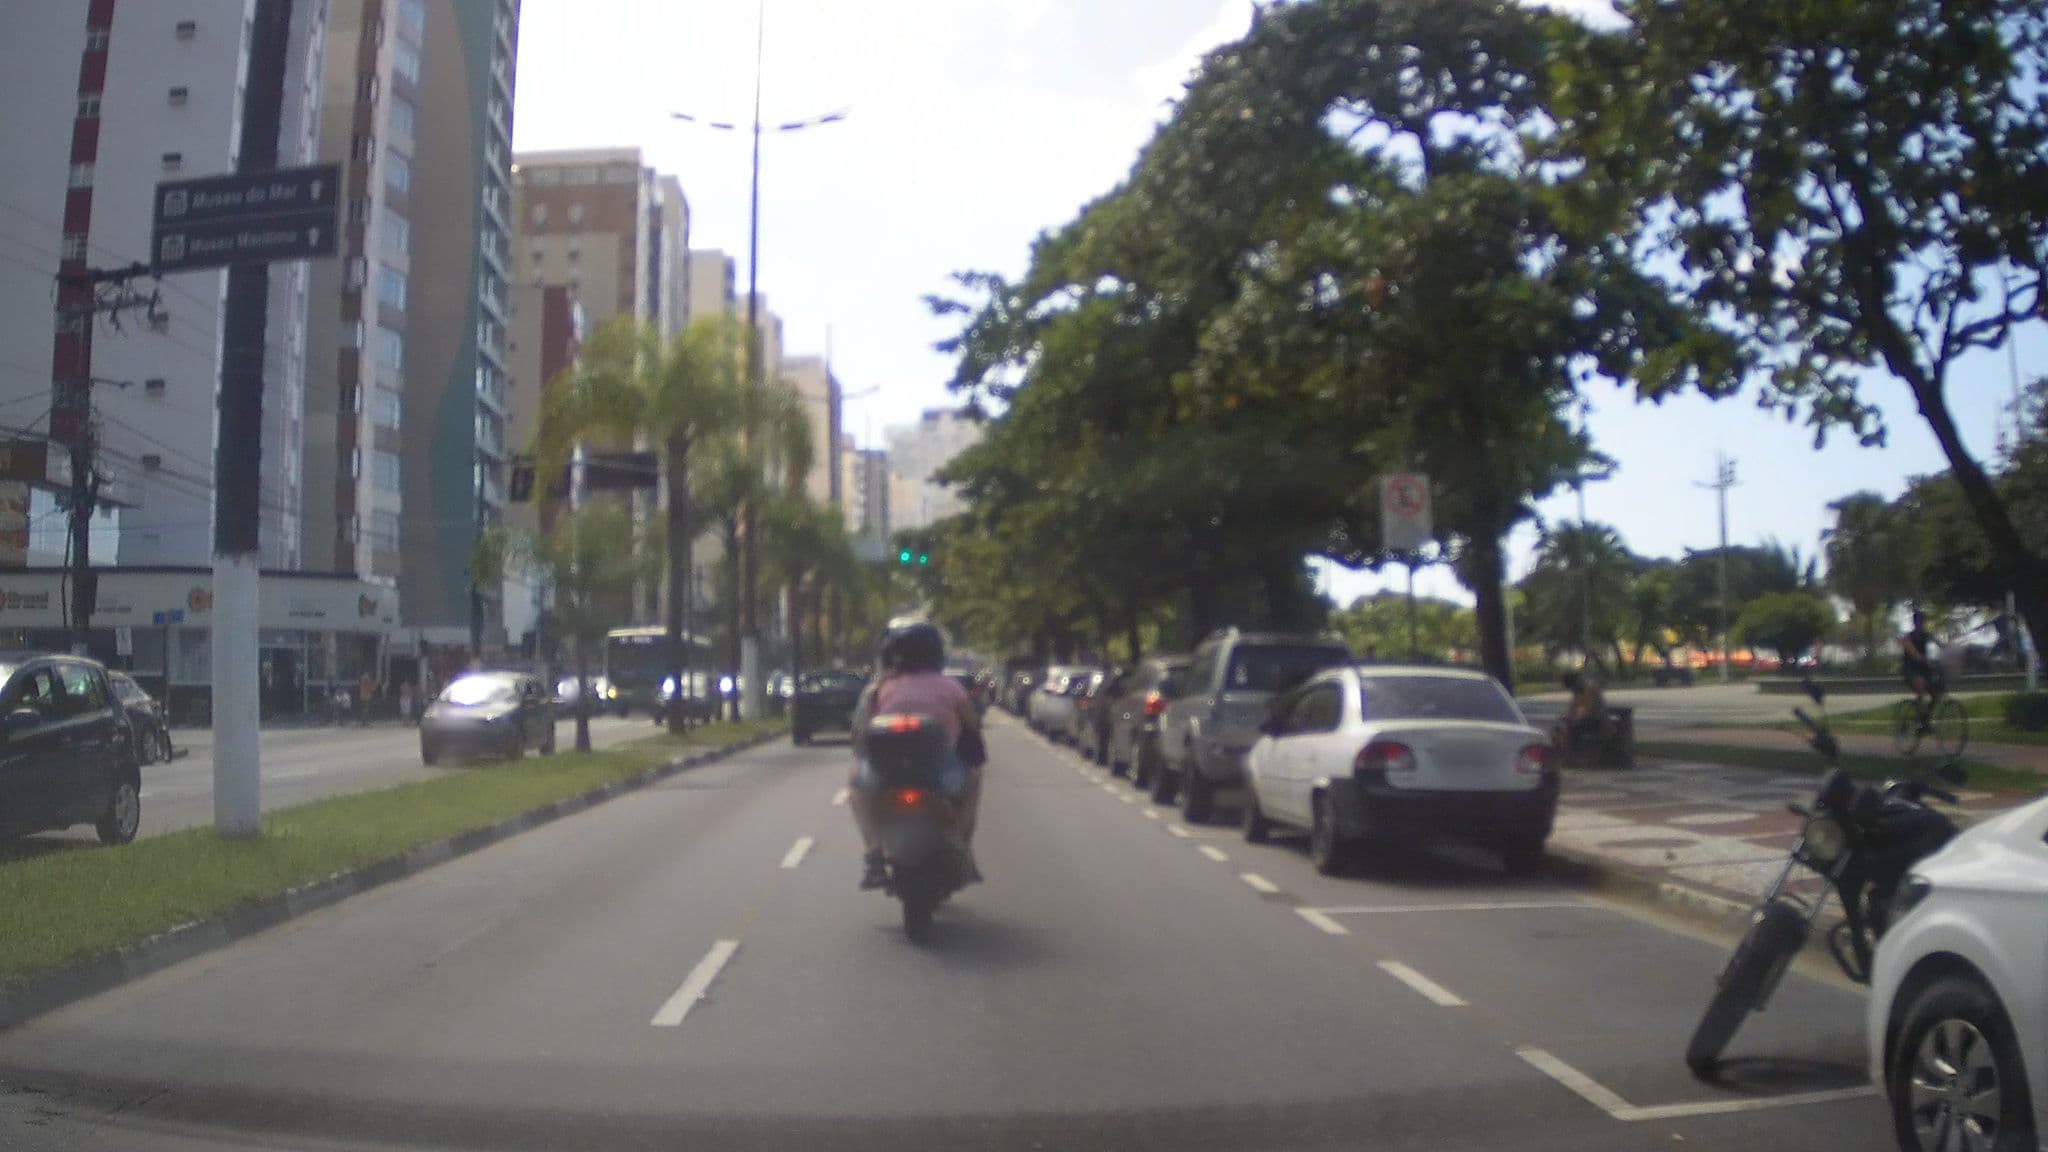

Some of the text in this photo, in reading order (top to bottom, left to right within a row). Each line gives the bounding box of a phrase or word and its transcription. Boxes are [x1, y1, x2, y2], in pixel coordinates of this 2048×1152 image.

[191, 191, 243, 209] Museu
[268, 183, 299, 201] Mar
[189, 237, 235, 253] Museu
